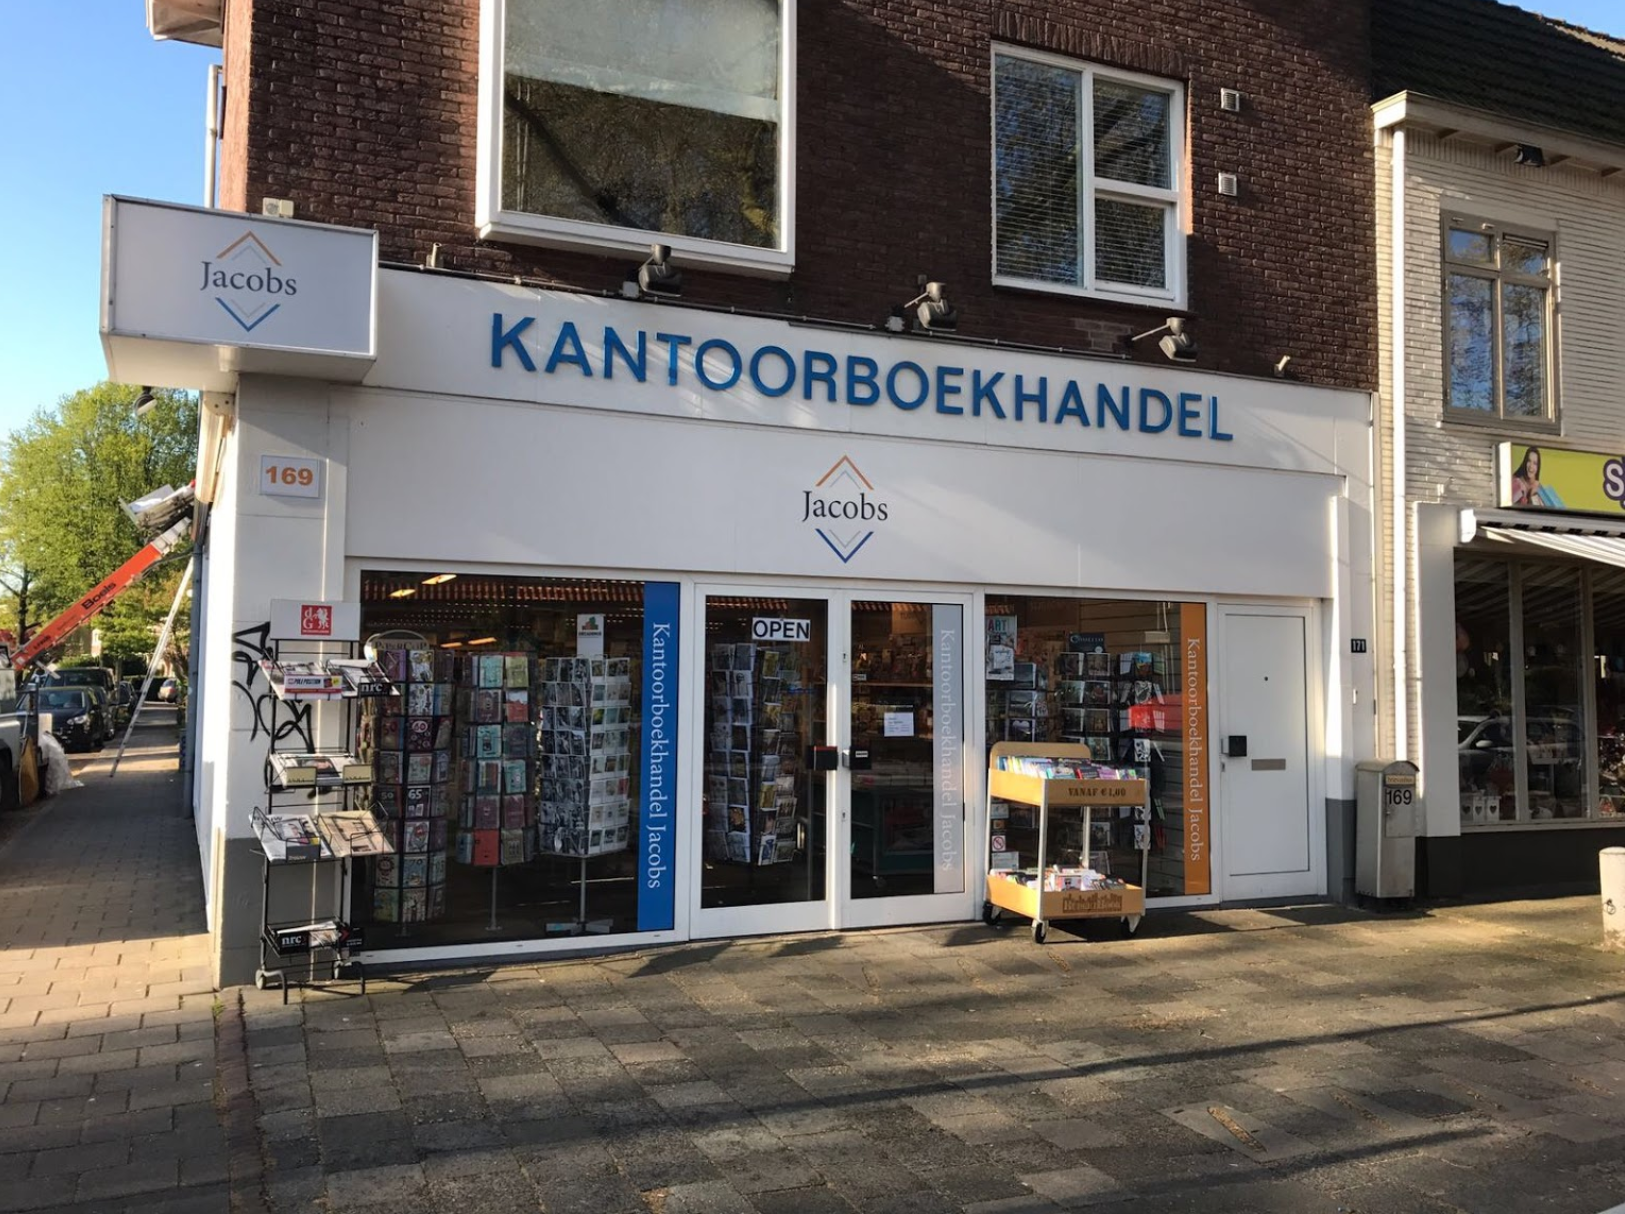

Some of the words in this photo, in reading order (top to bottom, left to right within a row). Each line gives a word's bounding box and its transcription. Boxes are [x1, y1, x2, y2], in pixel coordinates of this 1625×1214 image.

[200, 261, 297, 296] Jacobs
[491, 313, 1234, 441] KANTOORBOEKHANDEL
[265, 465, 314, 486] 169
[802, 490, 889, 522] Jacobs
[82, 582, 116, 610] Boels
[753, 619, 810, 639] OPEN
[1352, 640, 1366, 652] 171
[361, 684, 383, 693] nrc
[649, 622, 670, 819] Kantoorboekhandel
[939, 628, 955, 808] Kantoorboekhandel
[1187, 637, 1202, 802] Kantoorboekhandel
[1068, 787, 1098, 797] VANAF
[1387, 790, 1412, 805] 169
[940, 813, 957, 872] Jacobs
[1188, 806, 1201, 862] Jacobs
[646, 825, 668, 889] Jacobs
[281, 935, 302, 945] nrc
